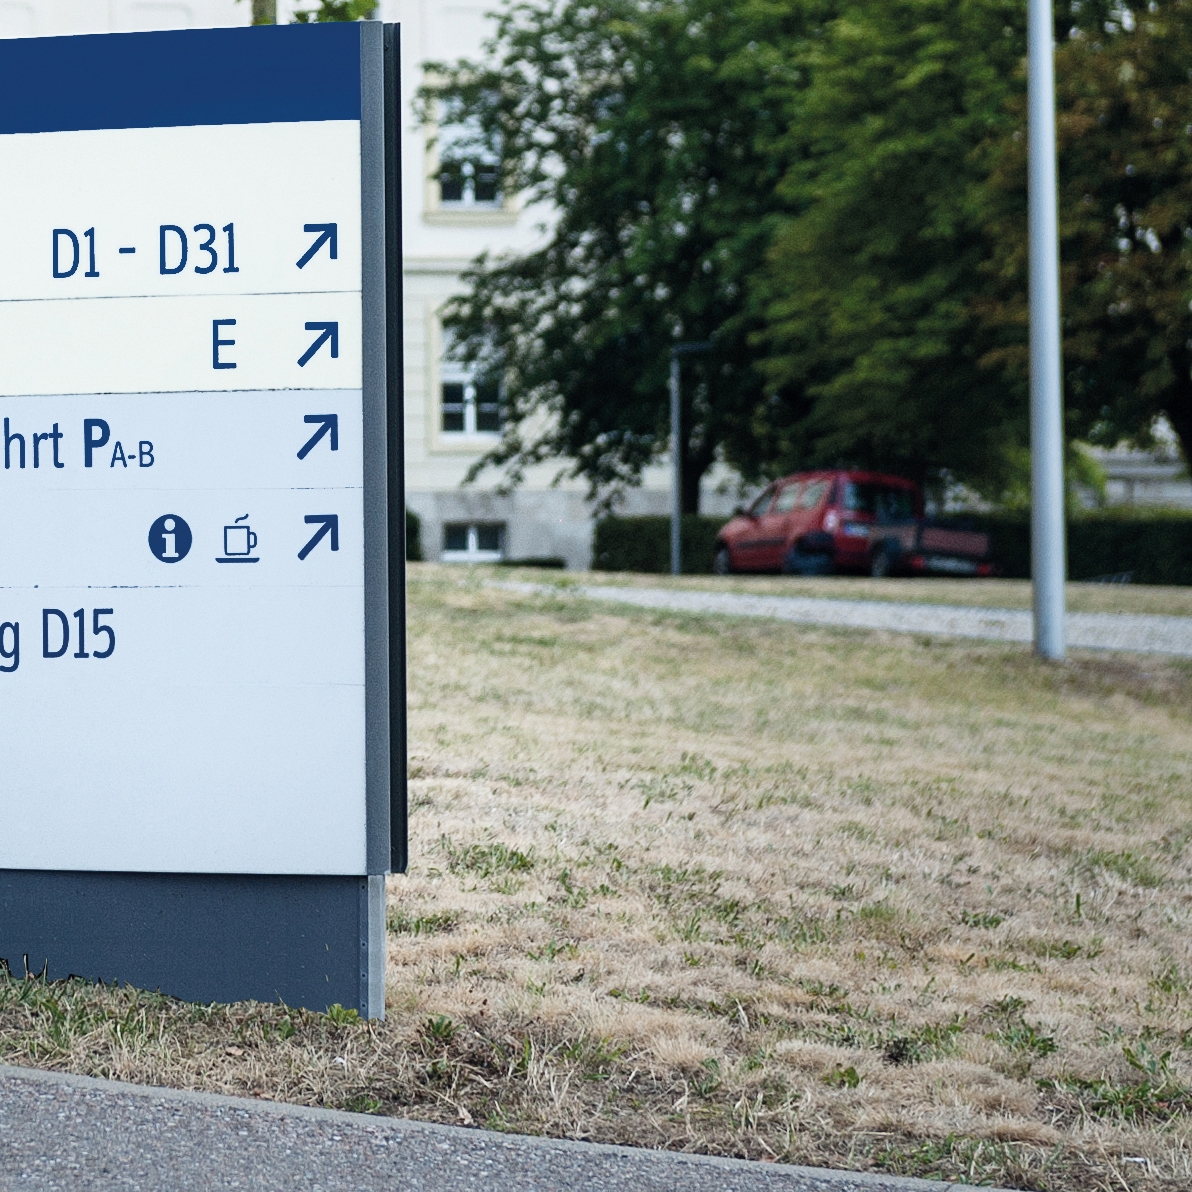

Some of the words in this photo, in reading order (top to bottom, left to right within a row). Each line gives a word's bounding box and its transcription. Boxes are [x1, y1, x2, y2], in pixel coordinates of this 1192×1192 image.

[52, 226, 100, 279] D1
[159, 222, 240, 276] D31
[212, 318, 238, 370] E
[42, 607, 116, 659] D15
